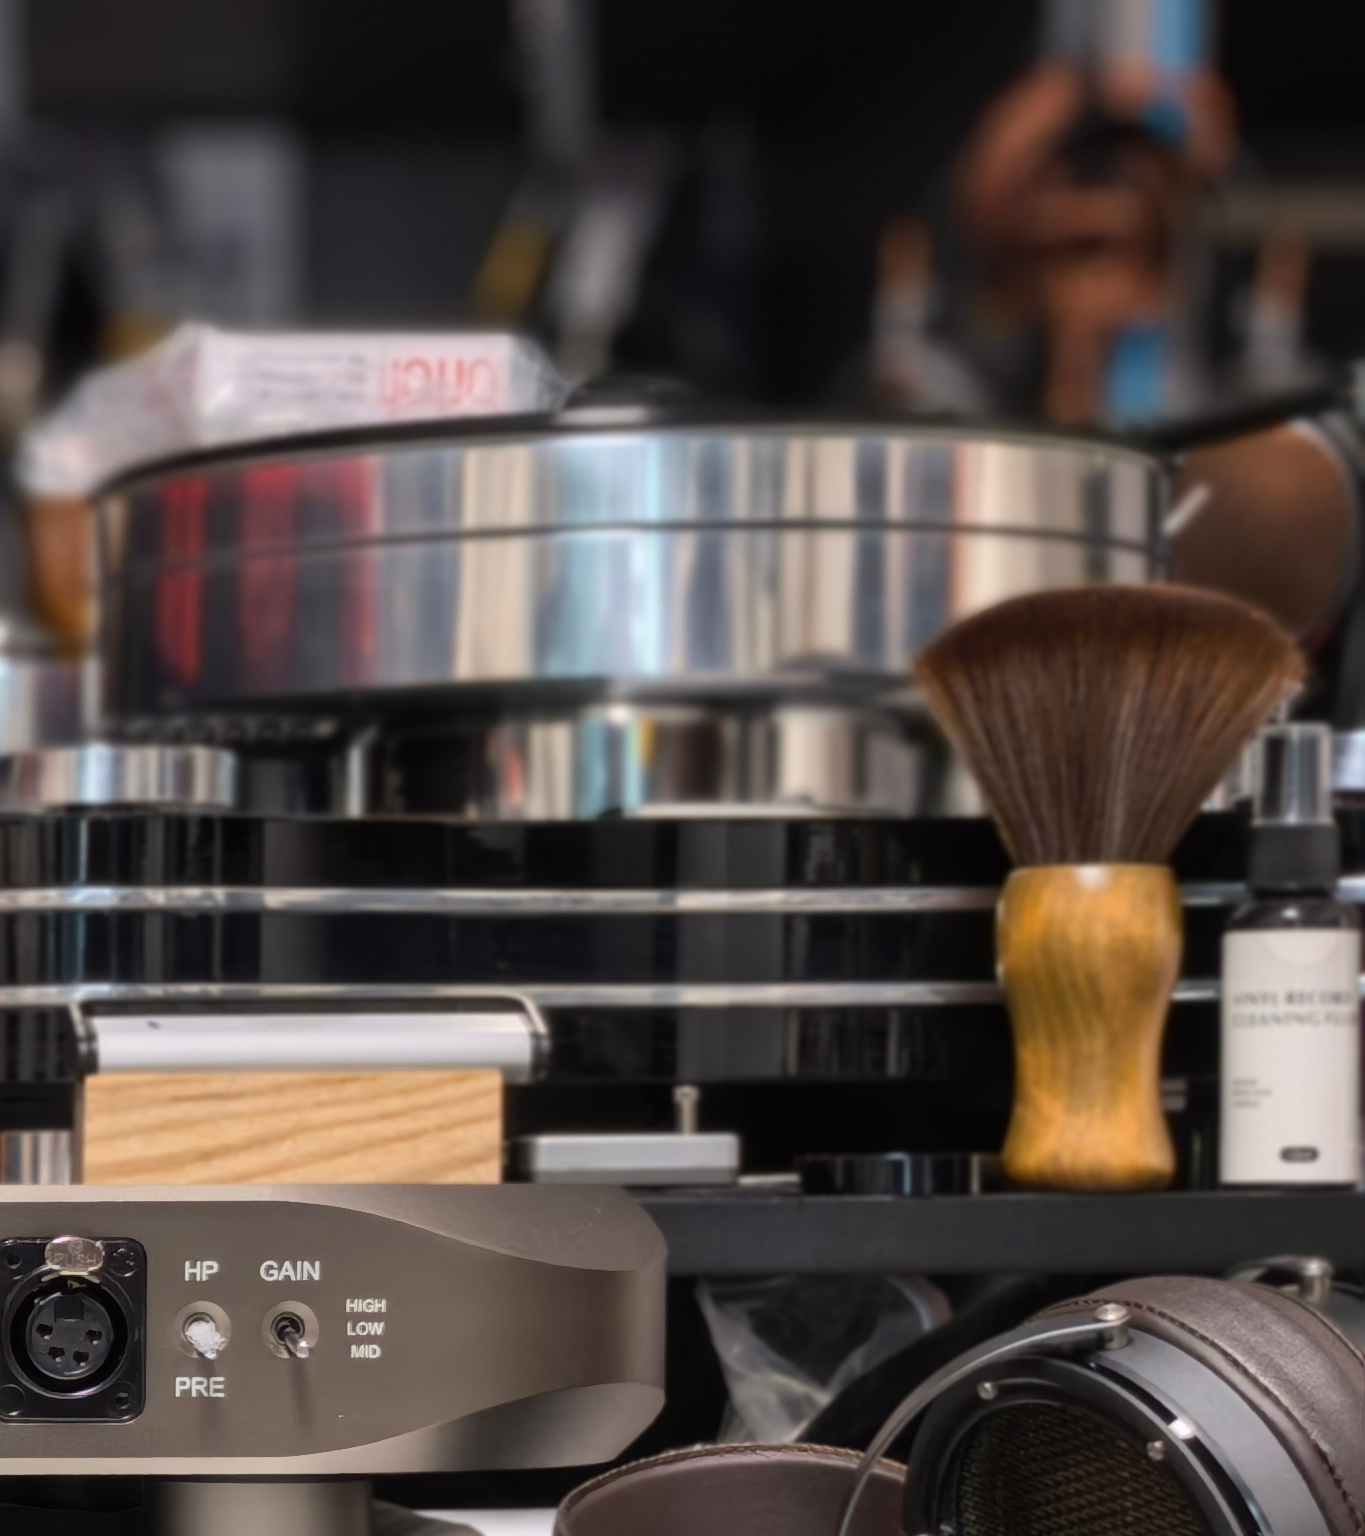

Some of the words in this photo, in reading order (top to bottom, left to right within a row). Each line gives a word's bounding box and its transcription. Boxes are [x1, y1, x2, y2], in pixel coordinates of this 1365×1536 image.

[184, 1260, 219, 1282] HP
[259, 1260, 321, 1282] GAIN
[345, 1298, 387, 1313] HIGH
[346, 1321, 385, 1336] LOW
[350, 1344, 382, 1359] MID
[175, 1376, 226, 1398] PRE
